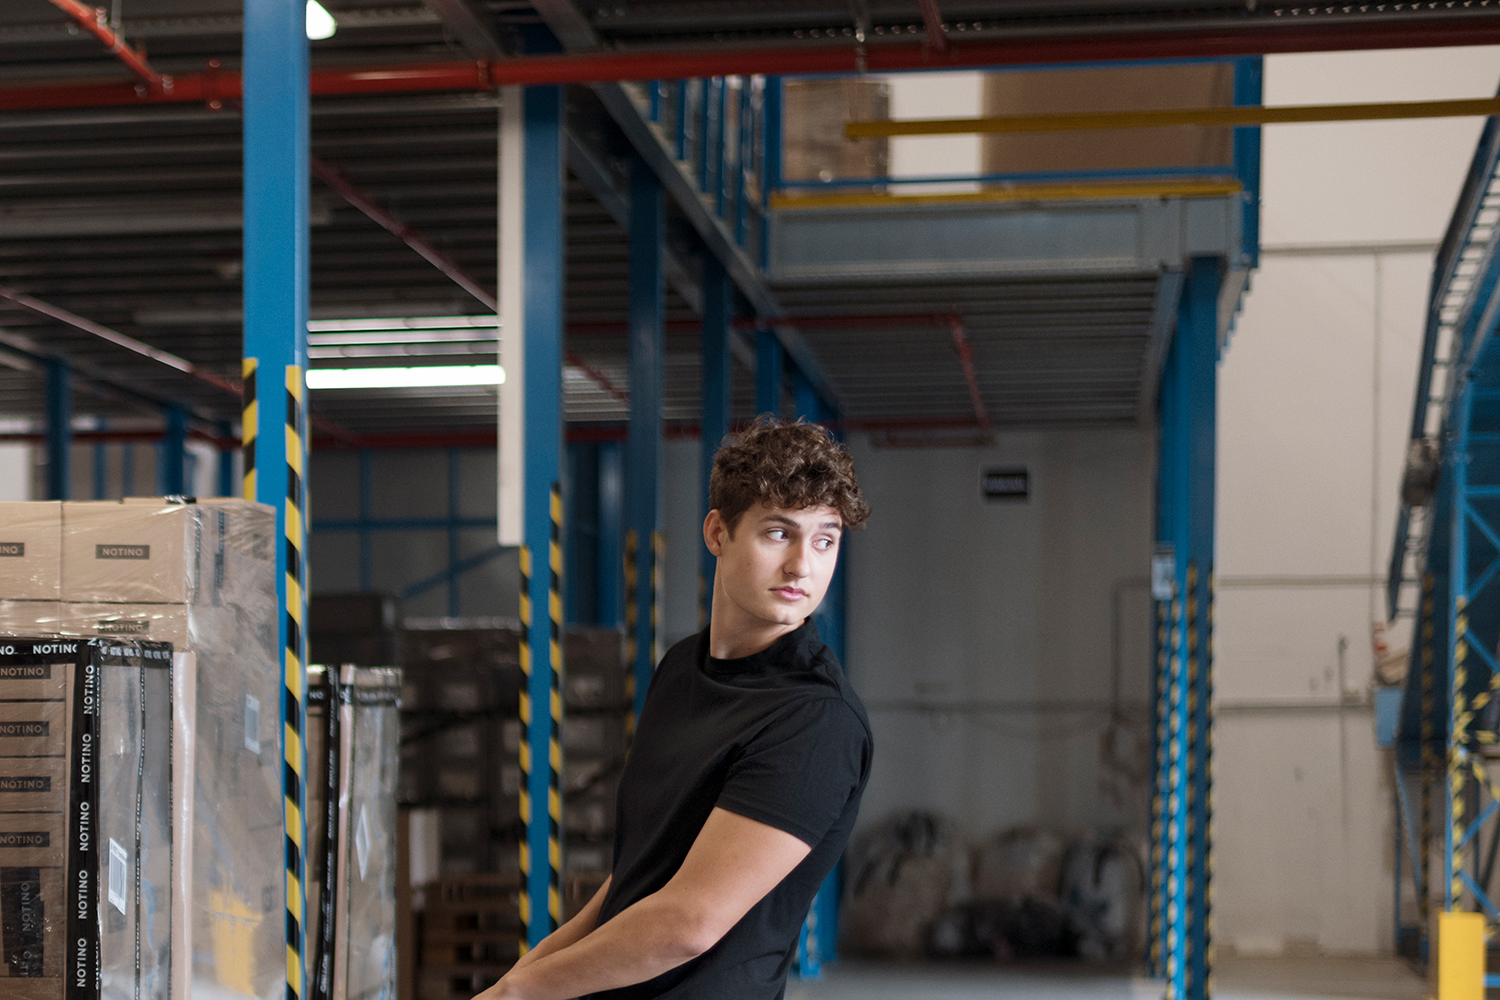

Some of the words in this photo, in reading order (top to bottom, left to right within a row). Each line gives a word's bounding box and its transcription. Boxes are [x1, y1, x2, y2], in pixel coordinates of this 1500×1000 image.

[102, 547, 143, 557] NOTINO
[0, 667, 44, 676] NOTINO
[84, 665, 94, 715] NOTINO
[0, 725, 42, 734] NOTINO
[81, 733, 92, 783] NOTINO
[0, 780, 44, 789] NOTINO
[0, 835, 43, 844] NOTINO
[79, 801, 90, 851] NOTINO
[78, 870, 88, 920] NOTINO
[77, 938, 87, 988] NOTINO
